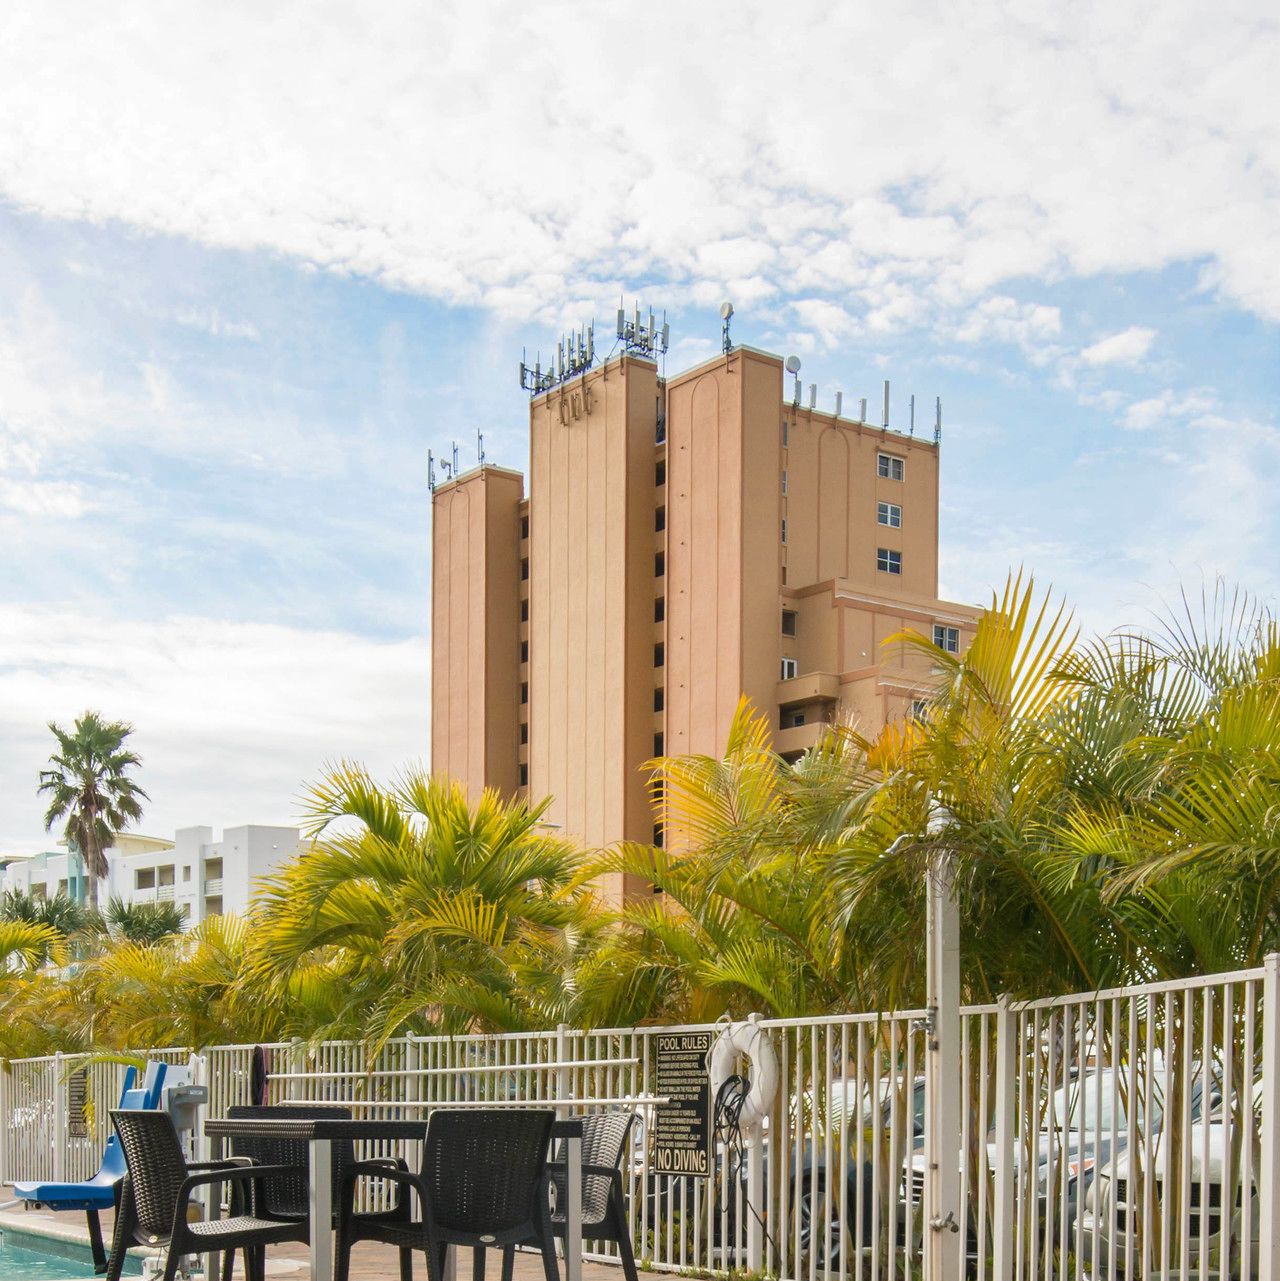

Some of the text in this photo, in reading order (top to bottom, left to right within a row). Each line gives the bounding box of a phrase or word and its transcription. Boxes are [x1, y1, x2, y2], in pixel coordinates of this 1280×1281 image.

[660, 1036, 708, 1050] POOL RULES
[657, 1148, 707, 1172] NO DIVING
